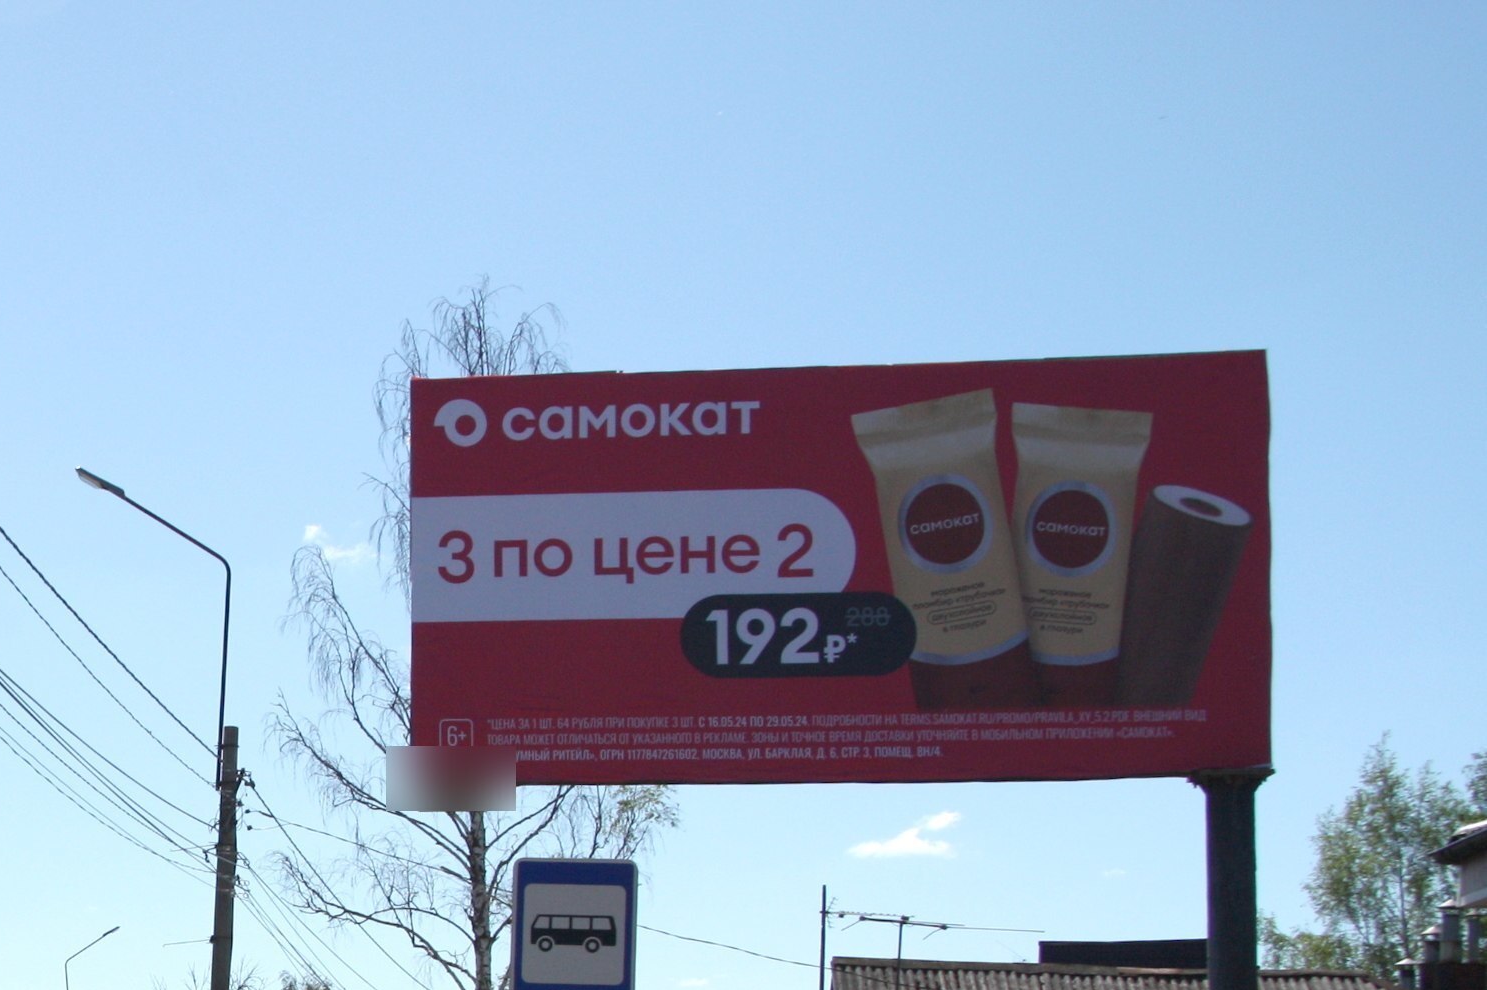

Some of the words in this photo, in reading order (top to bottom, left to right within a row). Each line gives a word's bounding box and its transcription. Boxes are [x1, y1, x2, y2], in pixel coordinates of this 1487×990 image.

[501, 400, 761, 441] самокат
[910, 513, 980, 535] самокат
[1036, 521, 1106, 537] самокат
[437, 530, 476, 584] 3
[494, 538, 573, 578] по
[594, 534, 761, 584] цене
[777, 523, 815, 578] 2
[845, 606, 891, 627] 288
[518, 718, 530, 730] ЗА
[532, 718, 537, 730] 1
[557, 717, 569, 729] 64
[571, 717, 603, 729] РУБЛЯ
[605, 717, 624, 729] ПРИ
[626, 716, 668, 728] ПОКУПКЕ
[672, 716, 678, 728] 3
[699, 715, 705, 727] С
[708, 715, 747, 727] 16.05.24
[750, 715, 764, 727] ПО
[812, 714, 882, 726] ПОДРОБНОСТИ
[885, 713, 897, 725] НА
[447, 725, 467, 747] 6+
[487, 733, 521, 745] ТОВАРА
[523, 733, 555, 745] МОЖЕТ
[557, 733, 617, 745] ОТЛИЧАТЬСЯ
[618, 732, 630, 744] ОТ
[632, 732, 692, 744] УКАЗАННОГО
[694, 731, 701, 743] В
[752, 731, 779, 743] ЗОНЫ
[781, 730, 789, 742] И
[791, 730, 826, 742] ТОЧНОЕ
[828, 730, 862, 742] ВРЕМЯ
[864, 730, 915, 743] ДОСТАВКИ
[980, 728, 1044, 740] МОБИЛЬНОМ
[600, 749, 624, 761] ОГРН
[748, 748, 763, 761] УЛ.
